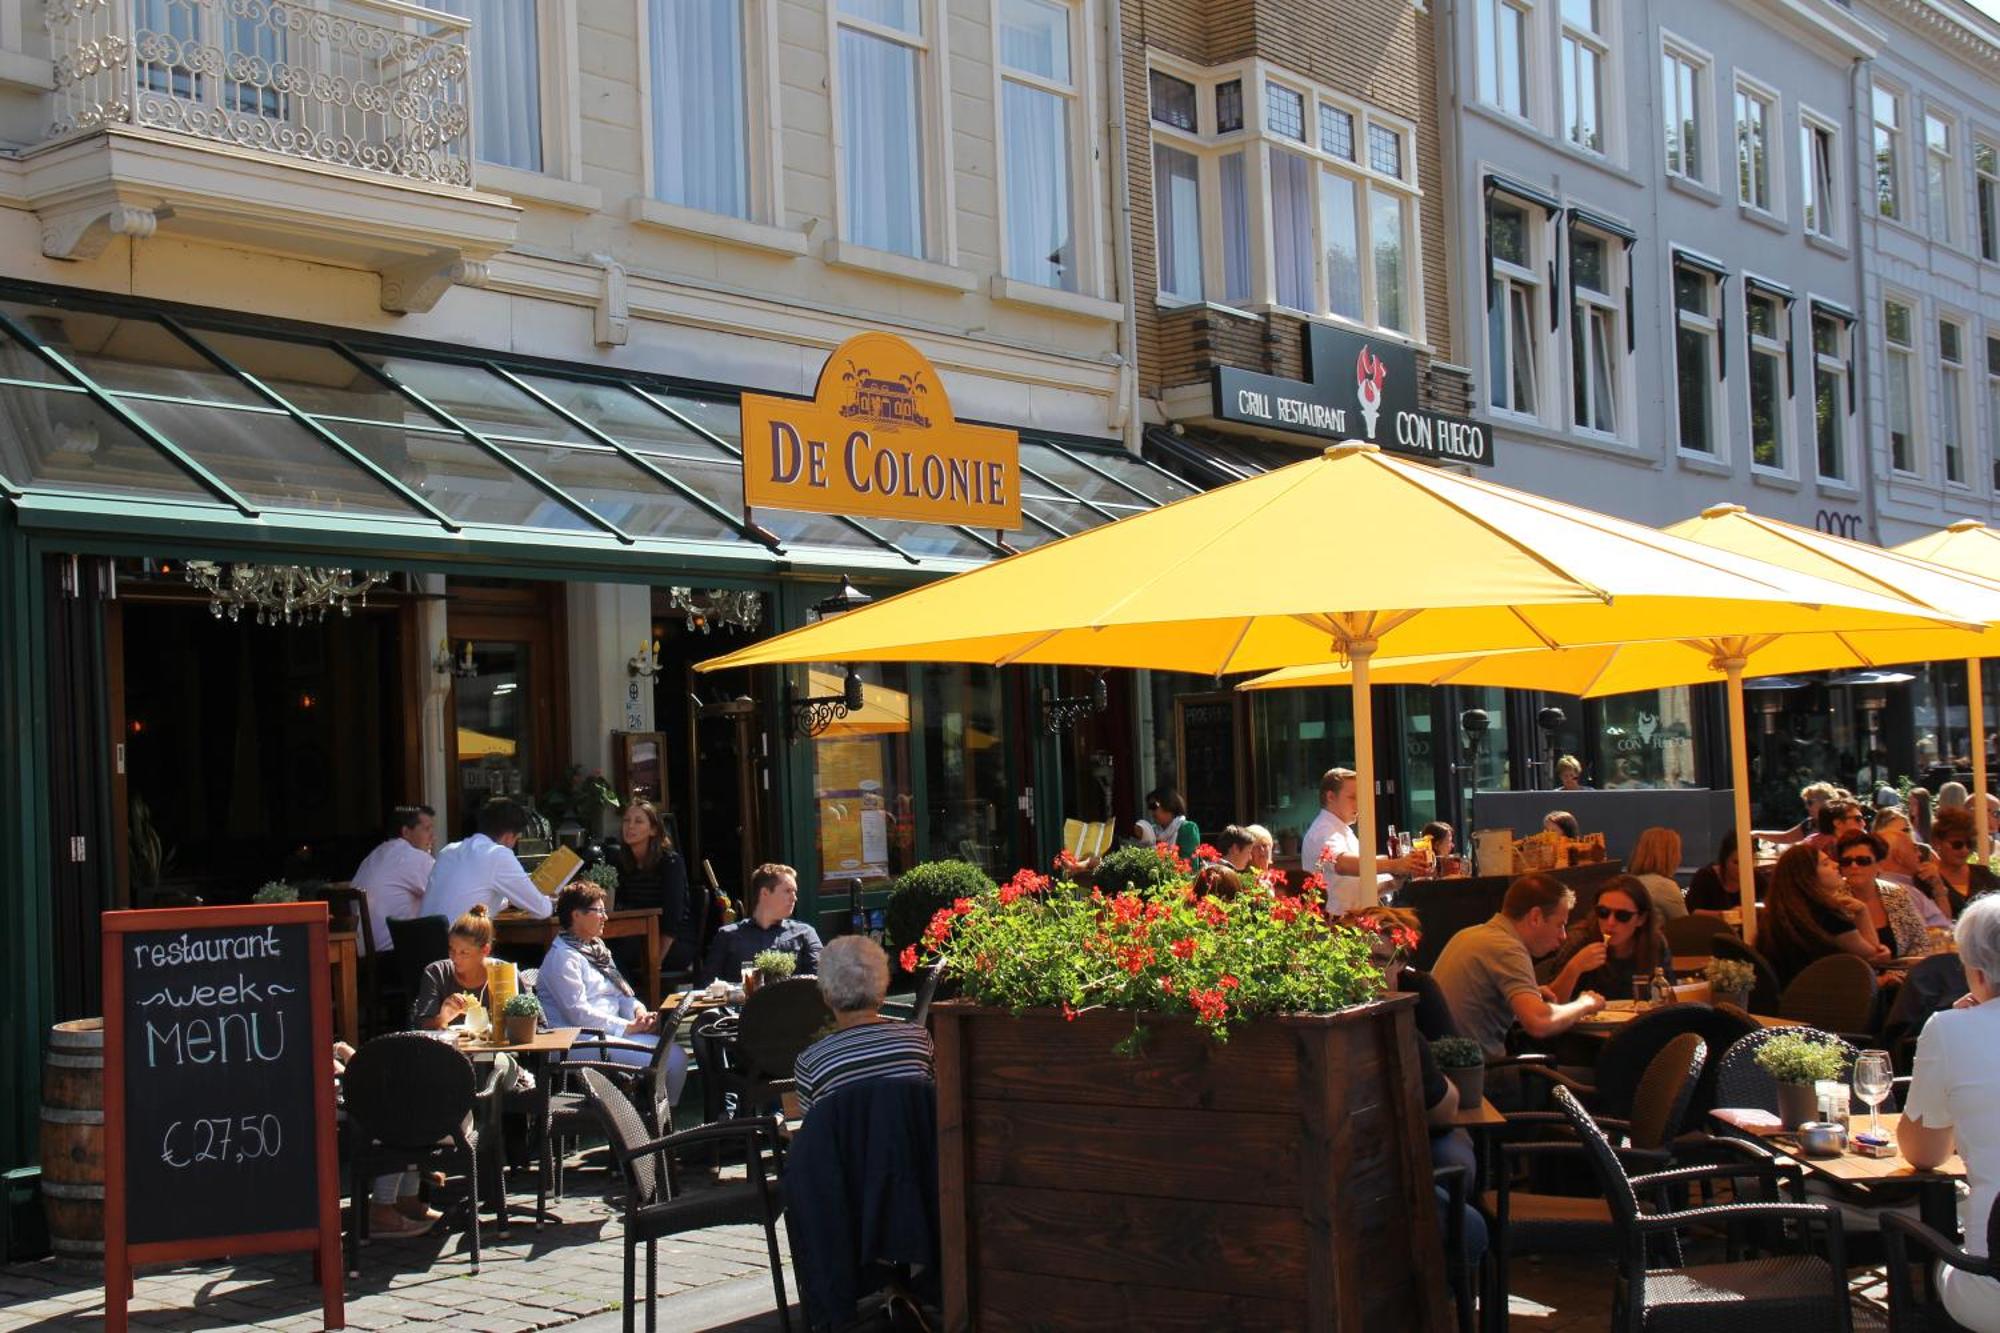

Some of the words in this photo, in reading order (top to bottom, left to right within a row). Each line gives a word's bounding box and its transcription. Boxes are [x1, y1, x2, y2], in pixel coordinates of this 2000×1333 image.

[1277, 397, 1346, 433] RESTAURANT
[1396, 410, 1433, 451] CON
[768, 420, 830, 489] DE
[843, 430, 1007, 507] COLONIE
[133, 925, 282, 969] restaurant
